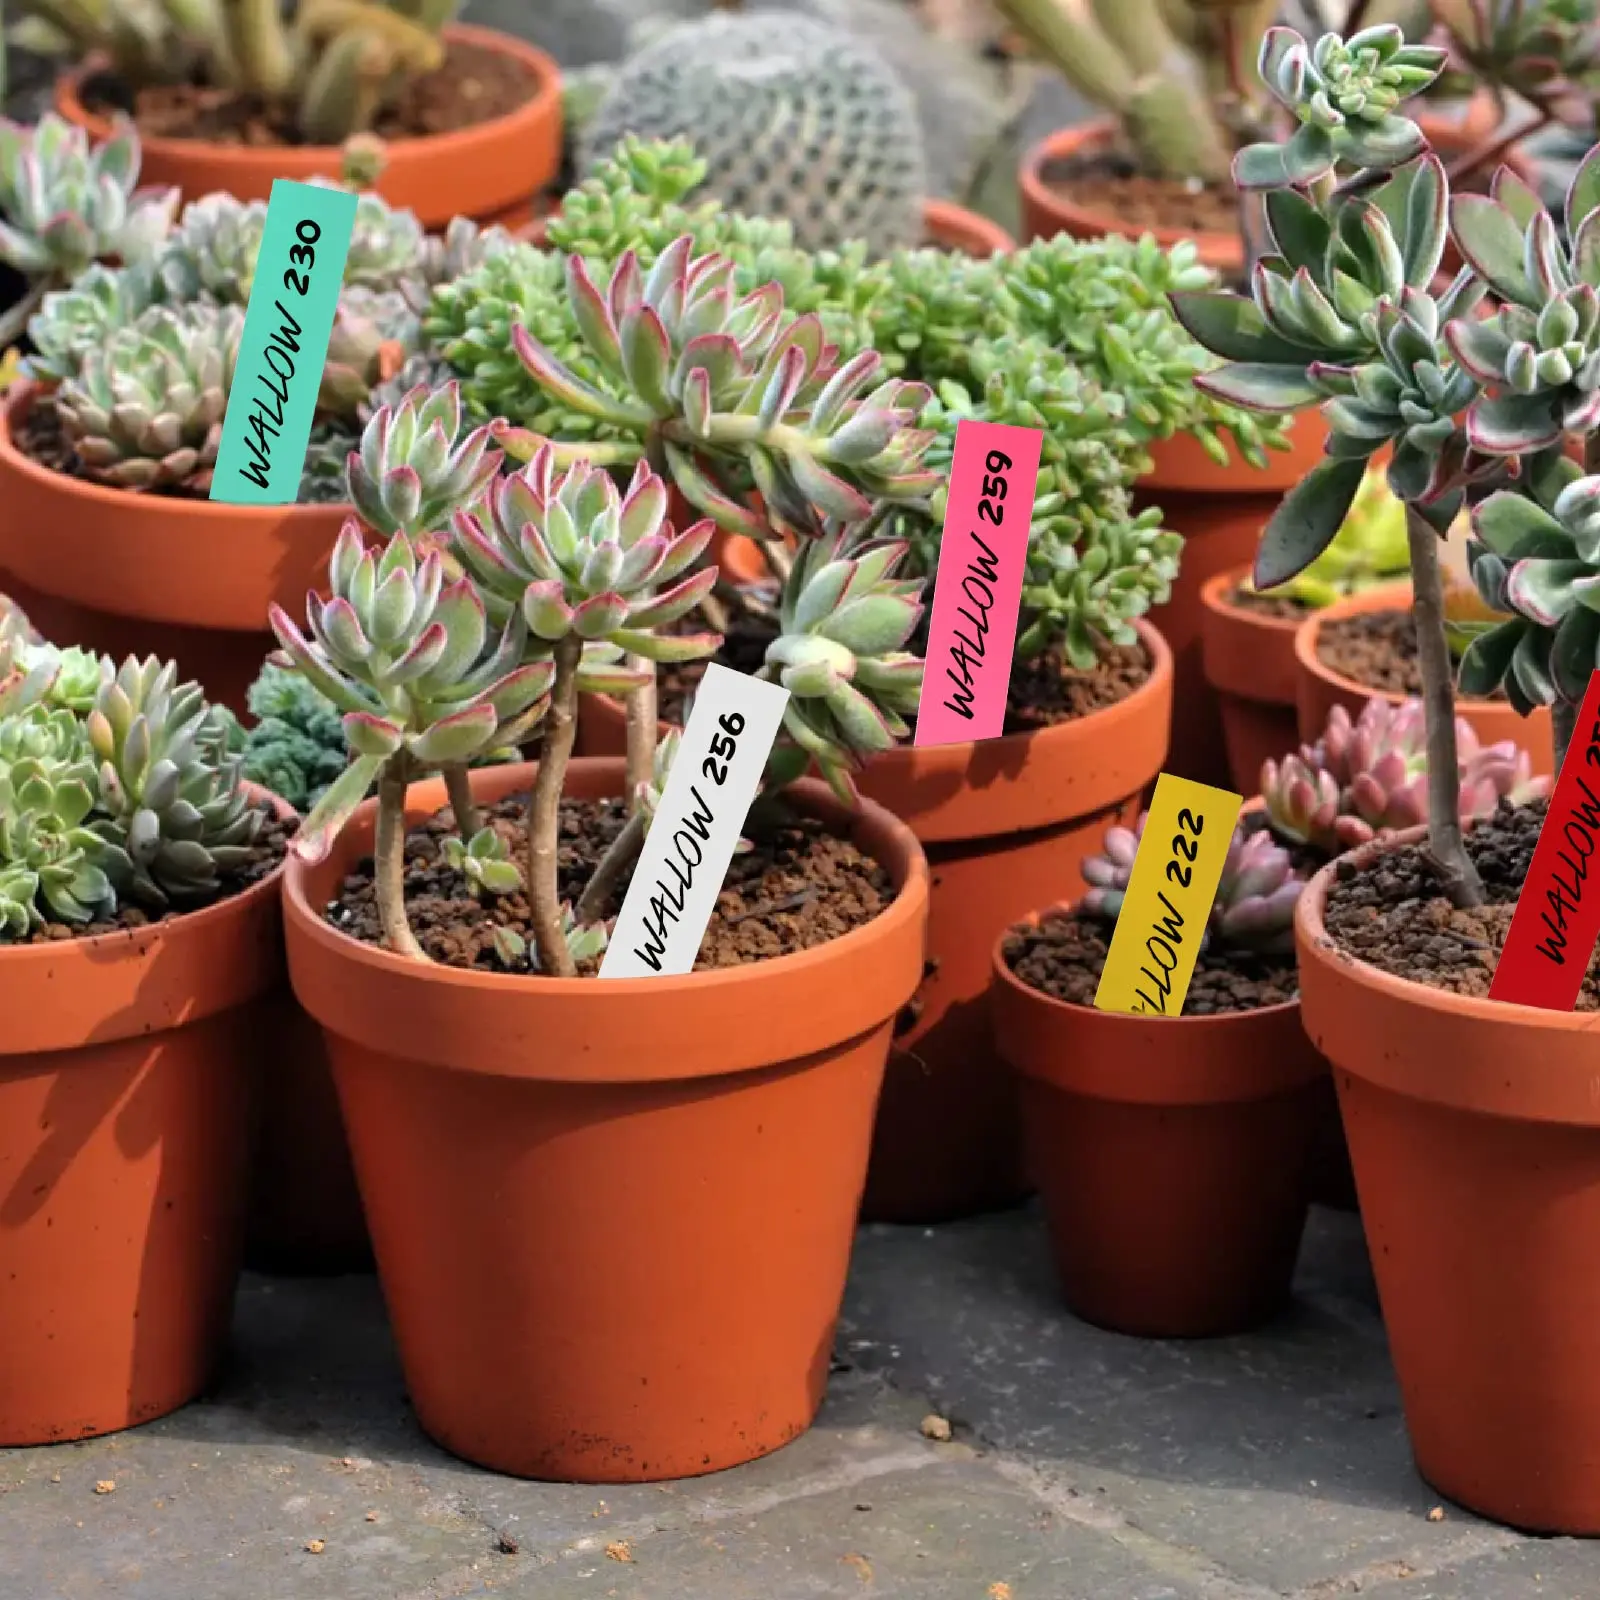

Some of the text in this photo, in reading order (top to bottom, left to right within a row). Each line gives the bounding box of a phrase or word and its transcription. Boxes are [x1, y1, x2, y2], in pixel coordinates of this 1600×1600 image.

[238, 219, 322, 489] WALLOW 230
[943, 449, 1013, 720] WALLOW 259
[633, 712, 746, 972] WALLOW 256
[1131, 808, 1204, 1014] LLOW 222
[1535, 777, 1600, 965] WALLOW
